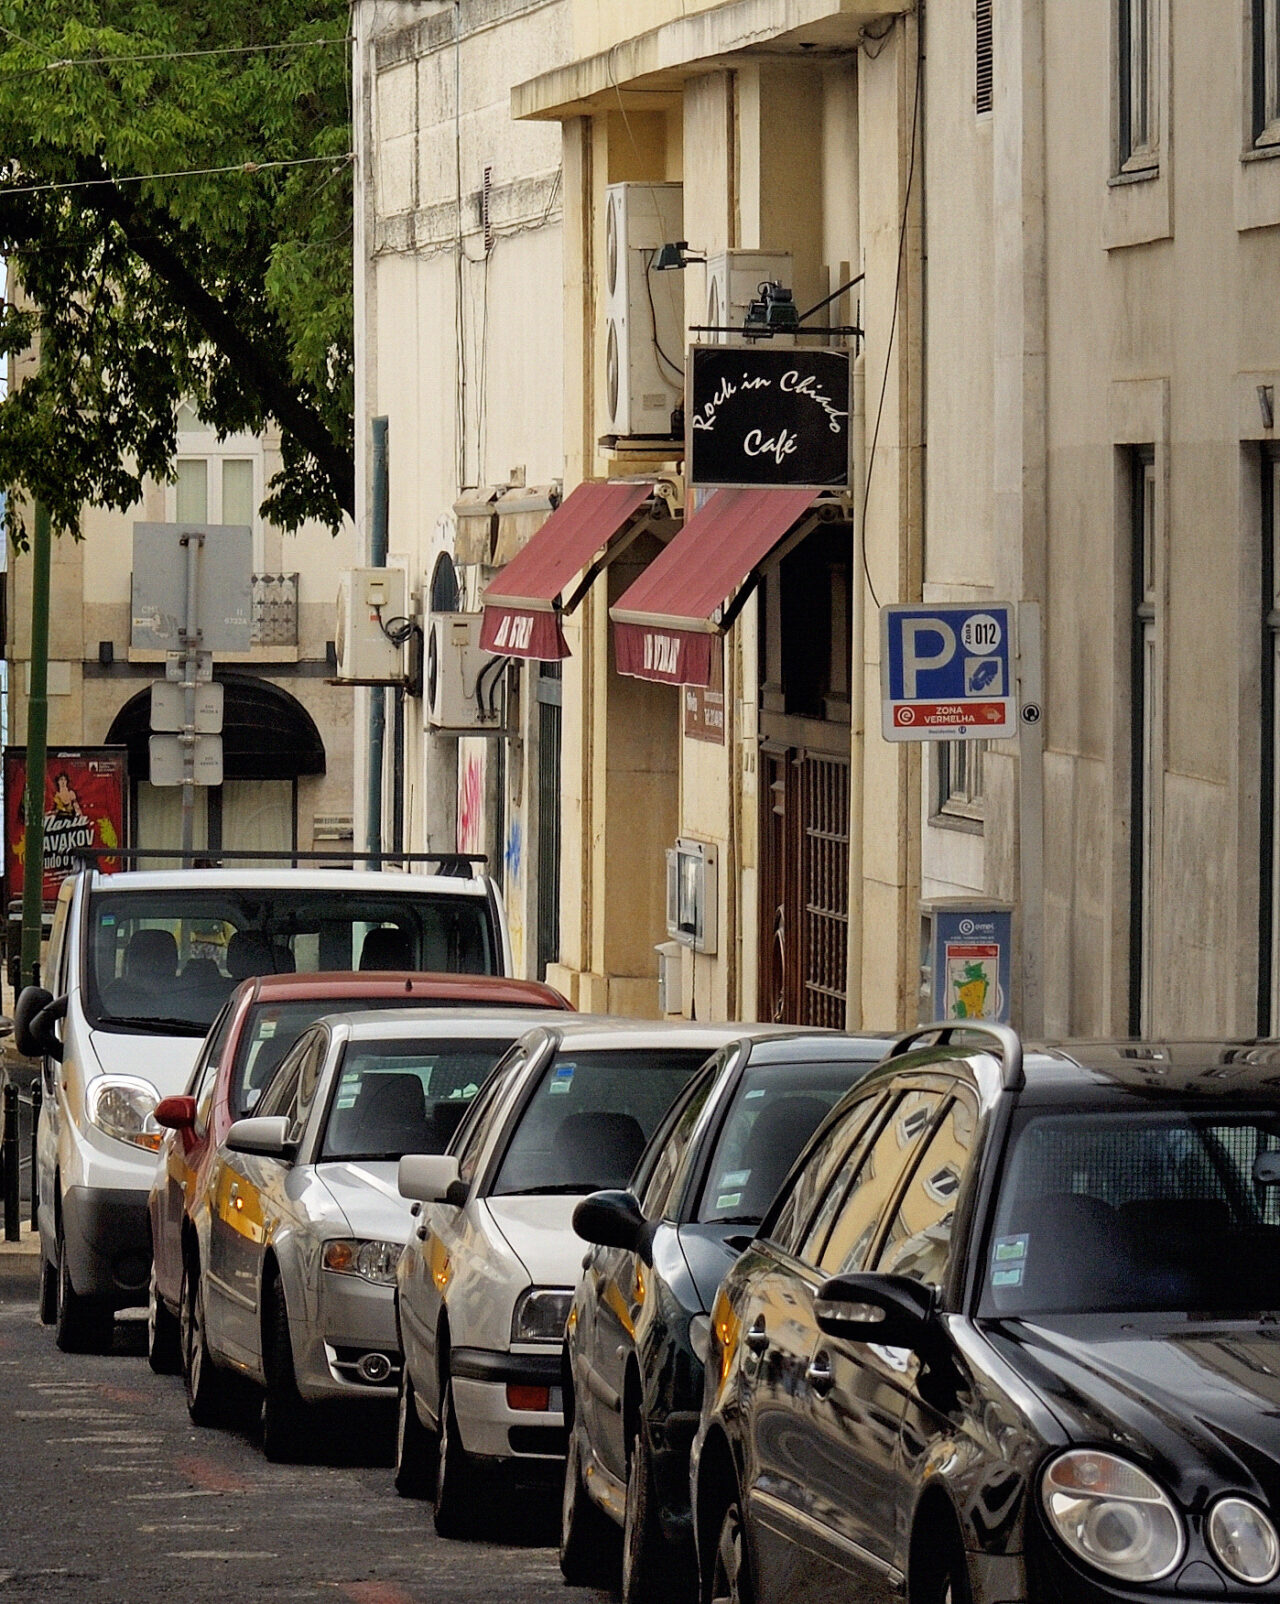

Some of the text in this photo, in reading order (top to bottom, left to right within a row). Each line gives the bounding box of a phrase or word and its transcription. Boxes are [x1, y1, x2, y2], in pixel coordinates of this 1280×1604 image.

[693, 371, 849, 433] Rock in Chiado
[743, 429, 797, 464] Café
[975, 623, 997, 645] 012
[901, 618, 957, 699] P
[923, 715, 976, 724] VERMELHA
[936, 706, 963, 715] ZONA
[44, 854, 61, 870] udo
